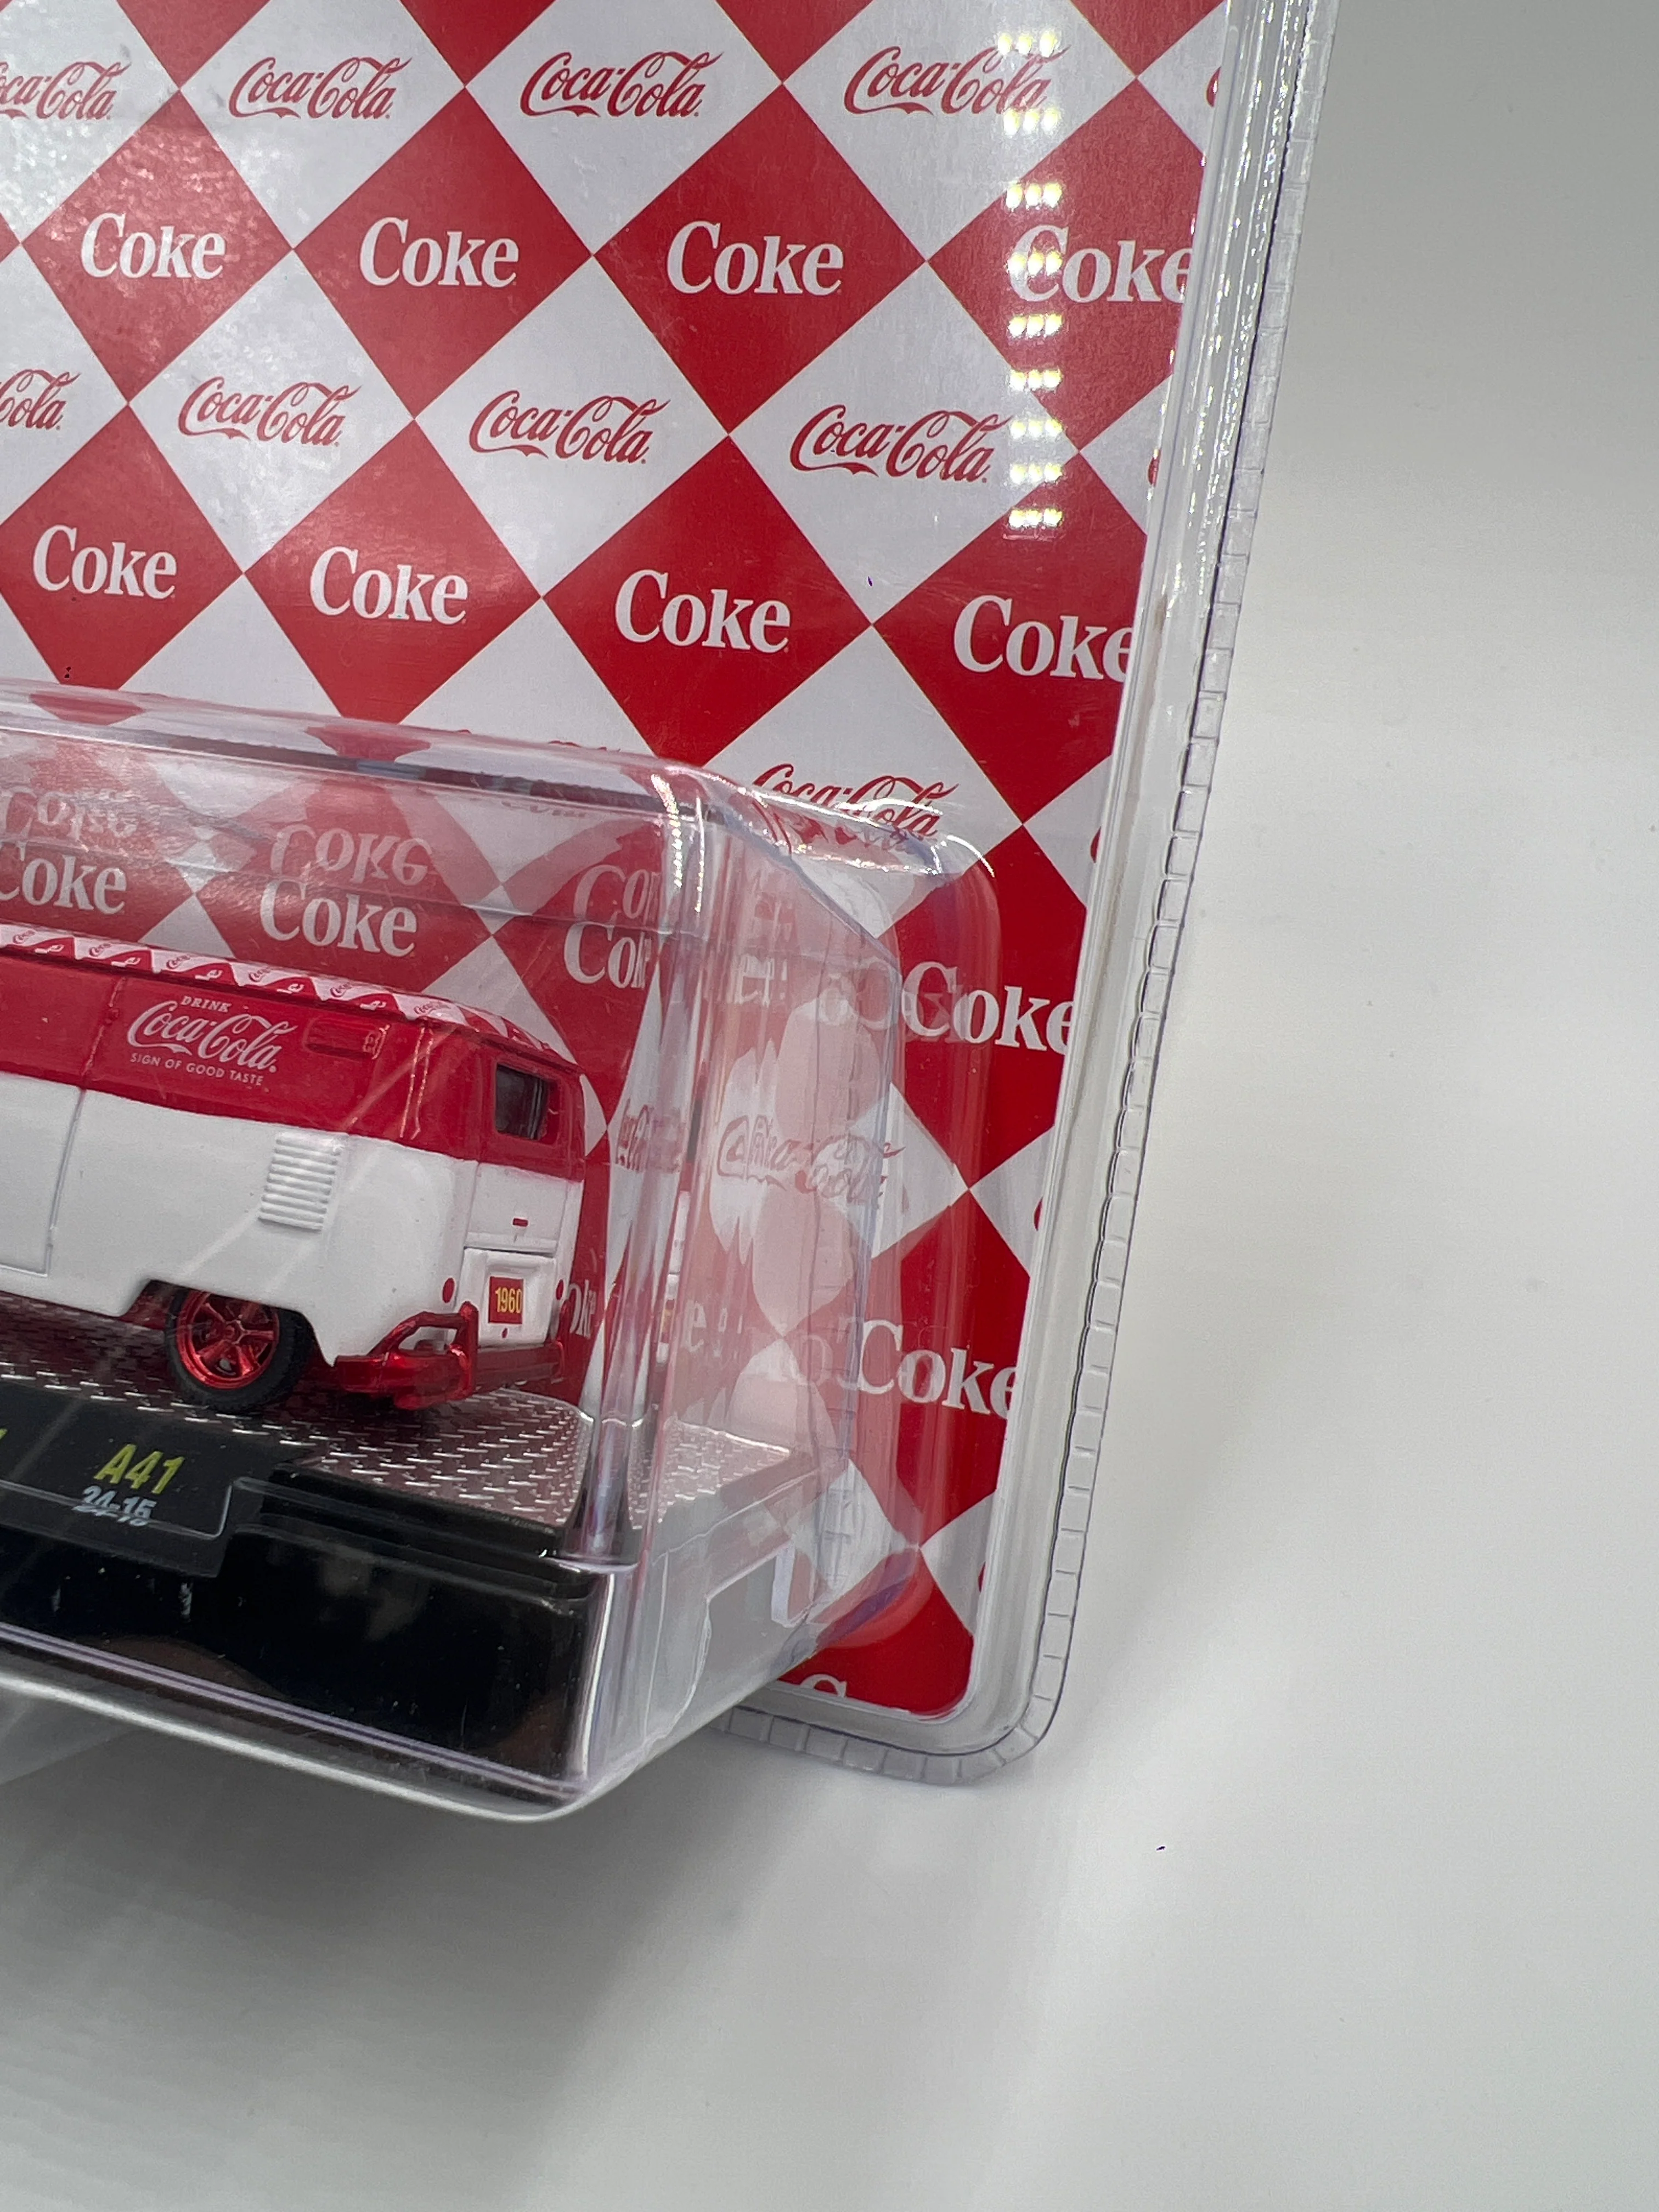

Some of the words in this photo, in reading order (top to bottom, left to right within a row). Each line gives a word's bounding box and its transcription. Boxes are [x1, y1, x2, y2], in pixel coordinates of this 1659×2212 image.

[0, 61, 132, 120] ca-Cola
[229, 57, 412, 119] Coca-Cola
[520, 51, 724, 117] Coca-Cola
[844, 46, 1069, 115] Coca-Cola
[81, 212, 225, 280] Coke
[360, 217, 519, 289] Coke
[667, 222, 843, 296] Coke
[178, 376, 362, 446] Coca-Cola
[469, 390, 670, 464] Coca-Cola
[790, 405, 1013, 483] Coca-Cola
[33, 524, 176, 599] Coke
[310, 547, 468, 625] Coke
[615, 570, 791, 653] Coke
[260, 879, 417, 957] Coke
[127, 1001, 298, 1071] Coca-Cola
[180, 996, 232, 1013] DRINK
[130, 1052, 161, 1066] SIGN
[165, 1058, 182, 1069] OF
[186, 1062, 224, 1078] GOOD
[230, 1070, 264, 1086] TASTE
[495, 1287, 522, 1313] 1960
[94, 1444, 185, 1495] A41
